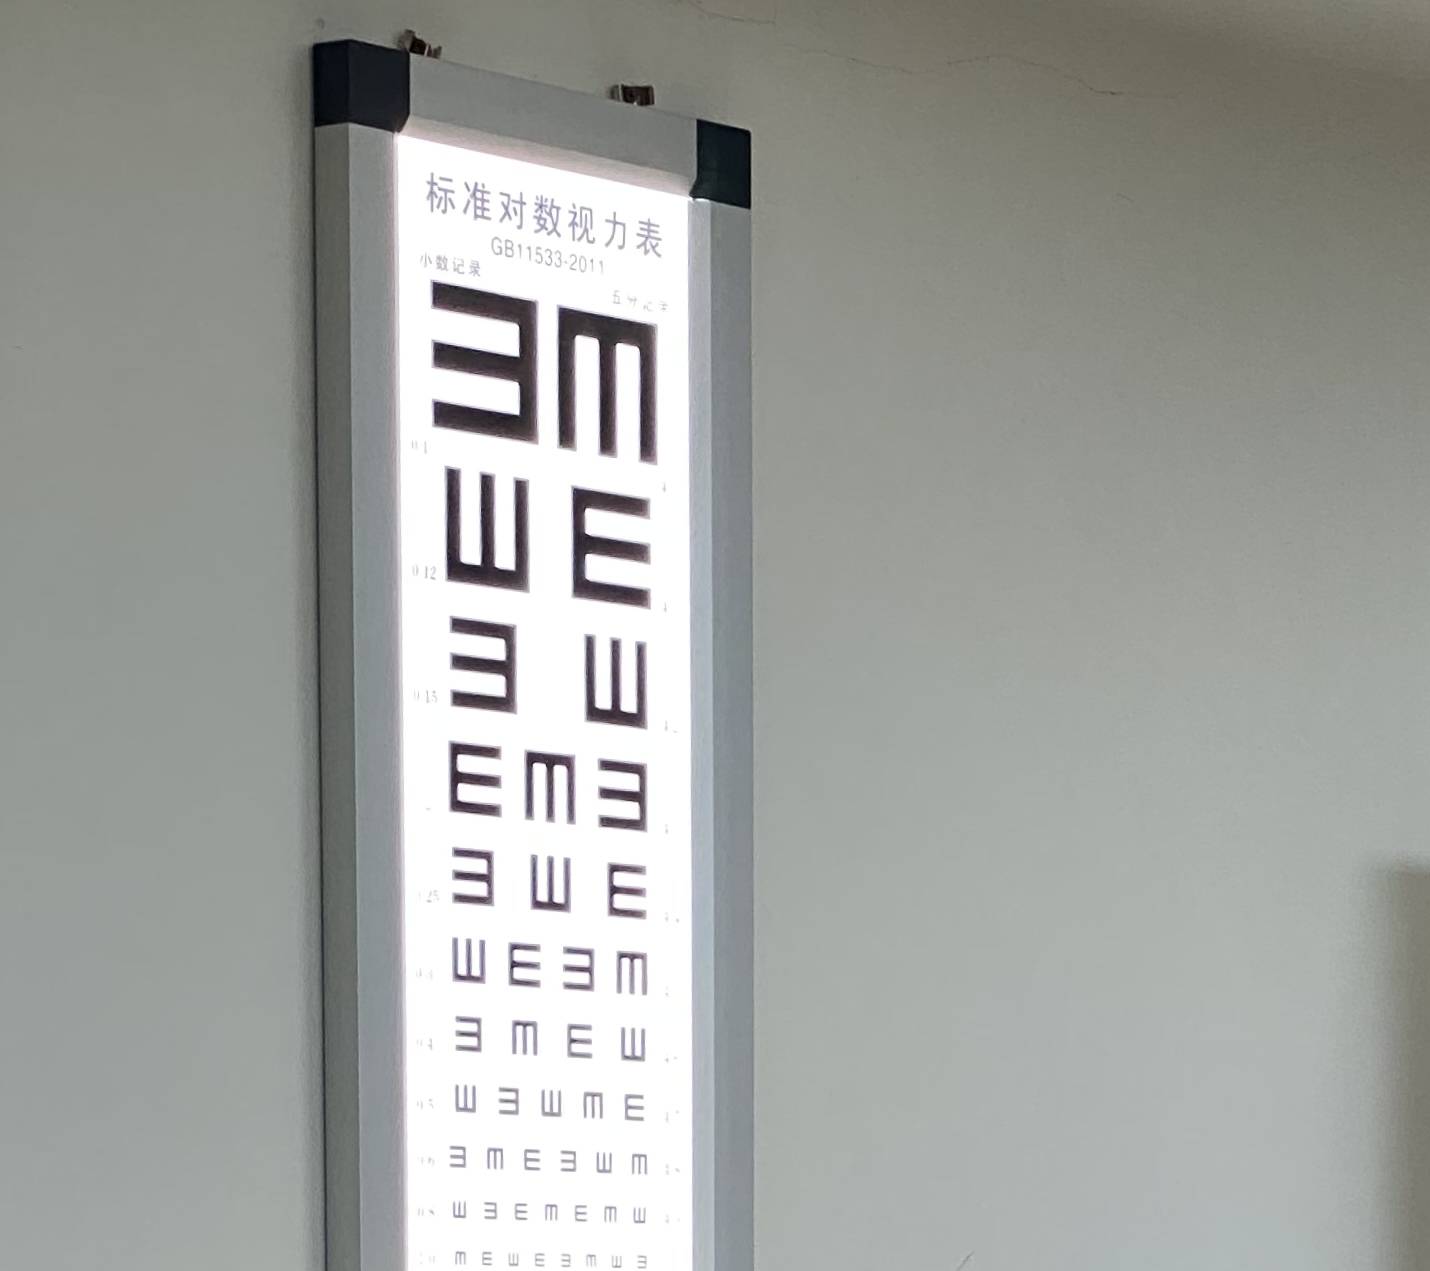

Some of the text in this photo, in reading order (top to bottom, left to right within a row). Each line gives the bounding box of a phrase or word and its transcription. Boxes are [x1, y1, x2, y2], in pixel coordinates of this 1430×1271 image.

[426, 172, 664, 258] 标准对数视力表
[490, 236, 605, 276] GB11533-2011
